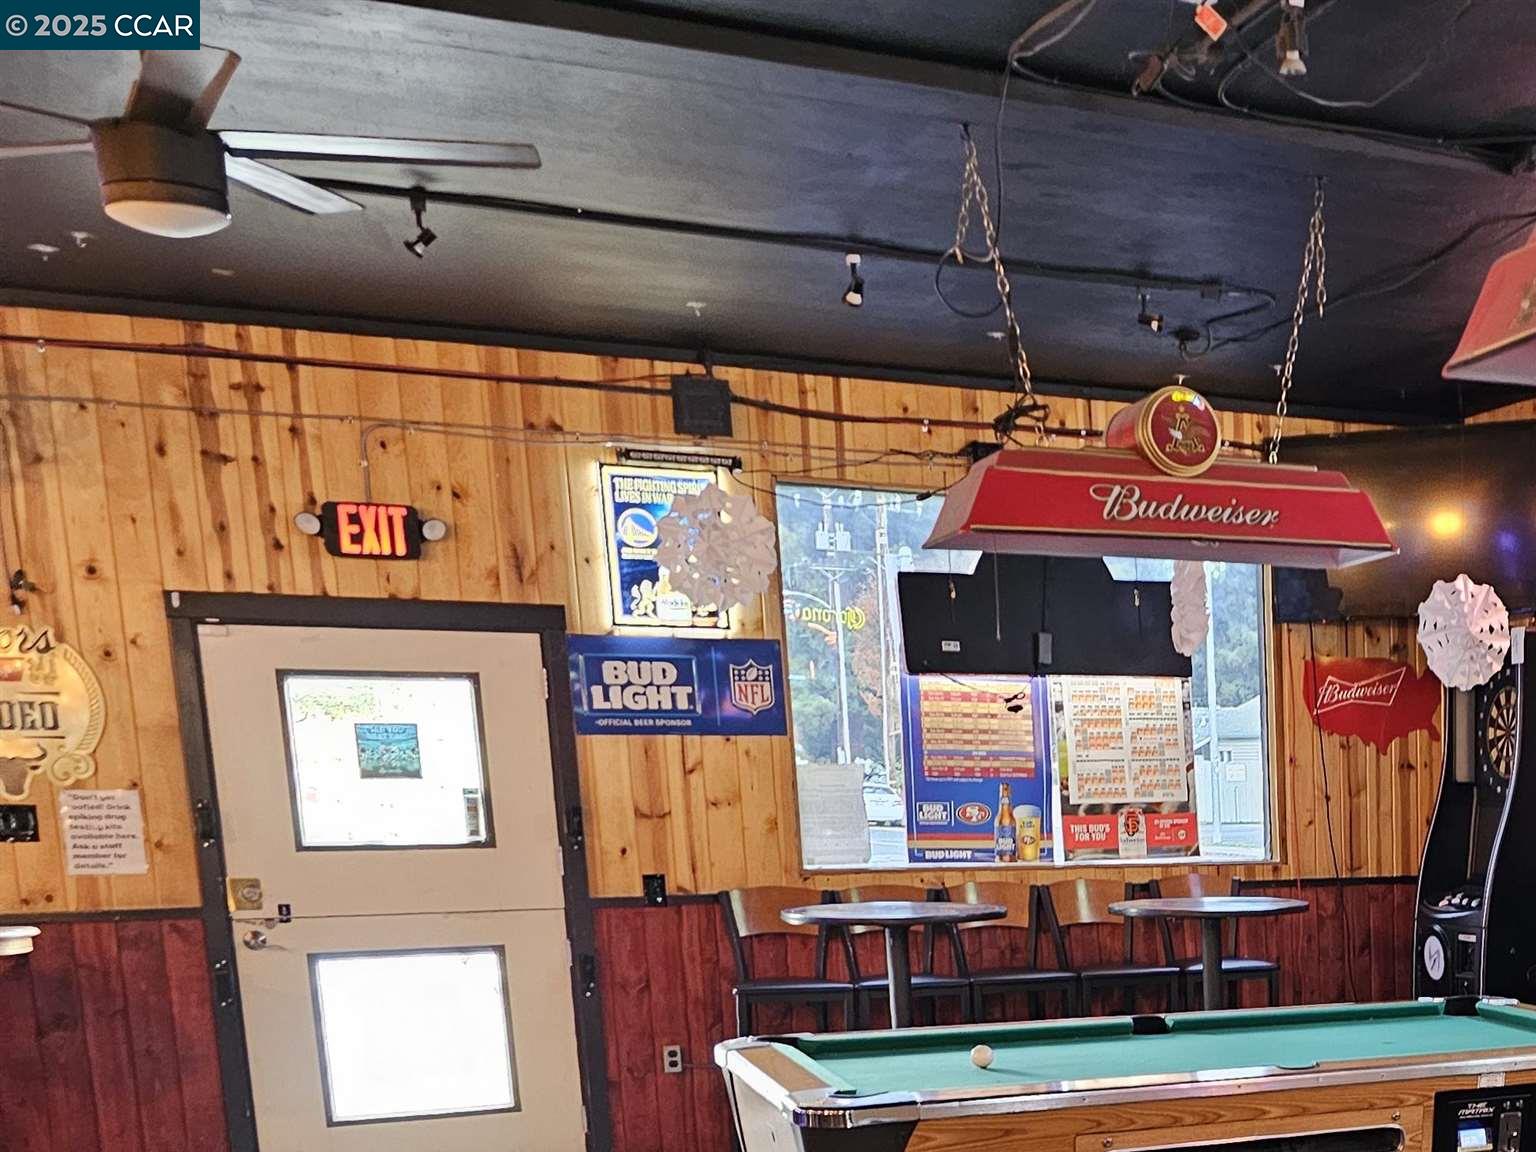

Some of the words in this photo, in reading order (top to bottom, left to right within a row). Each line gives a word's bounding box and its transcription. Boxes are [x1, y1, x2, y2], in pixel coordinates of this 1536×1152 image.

[1089, 483, 1279, 527] Budweiser
[336, 503, 408, 557] EXIT
[0, 628, 56, 654] ors
[602, 660, 678, 686] BUD
[590, 685, 693, 711] LIGHT
[737, 682, 769, 703] NFL
[1319, 681, 1398, 704] Budweiser
[0, 701, 60, 730] DEO
[596, 718, 632, 728] OFFICIAL
[634, 718, 654, 727] BEER
[655, 719, 692, 728] SPONSOR
[1070, 824, 1088, 833] THIS
[1075, 832, 1090, 842] FOR
[1091, 832, 1106, 841] YOU
